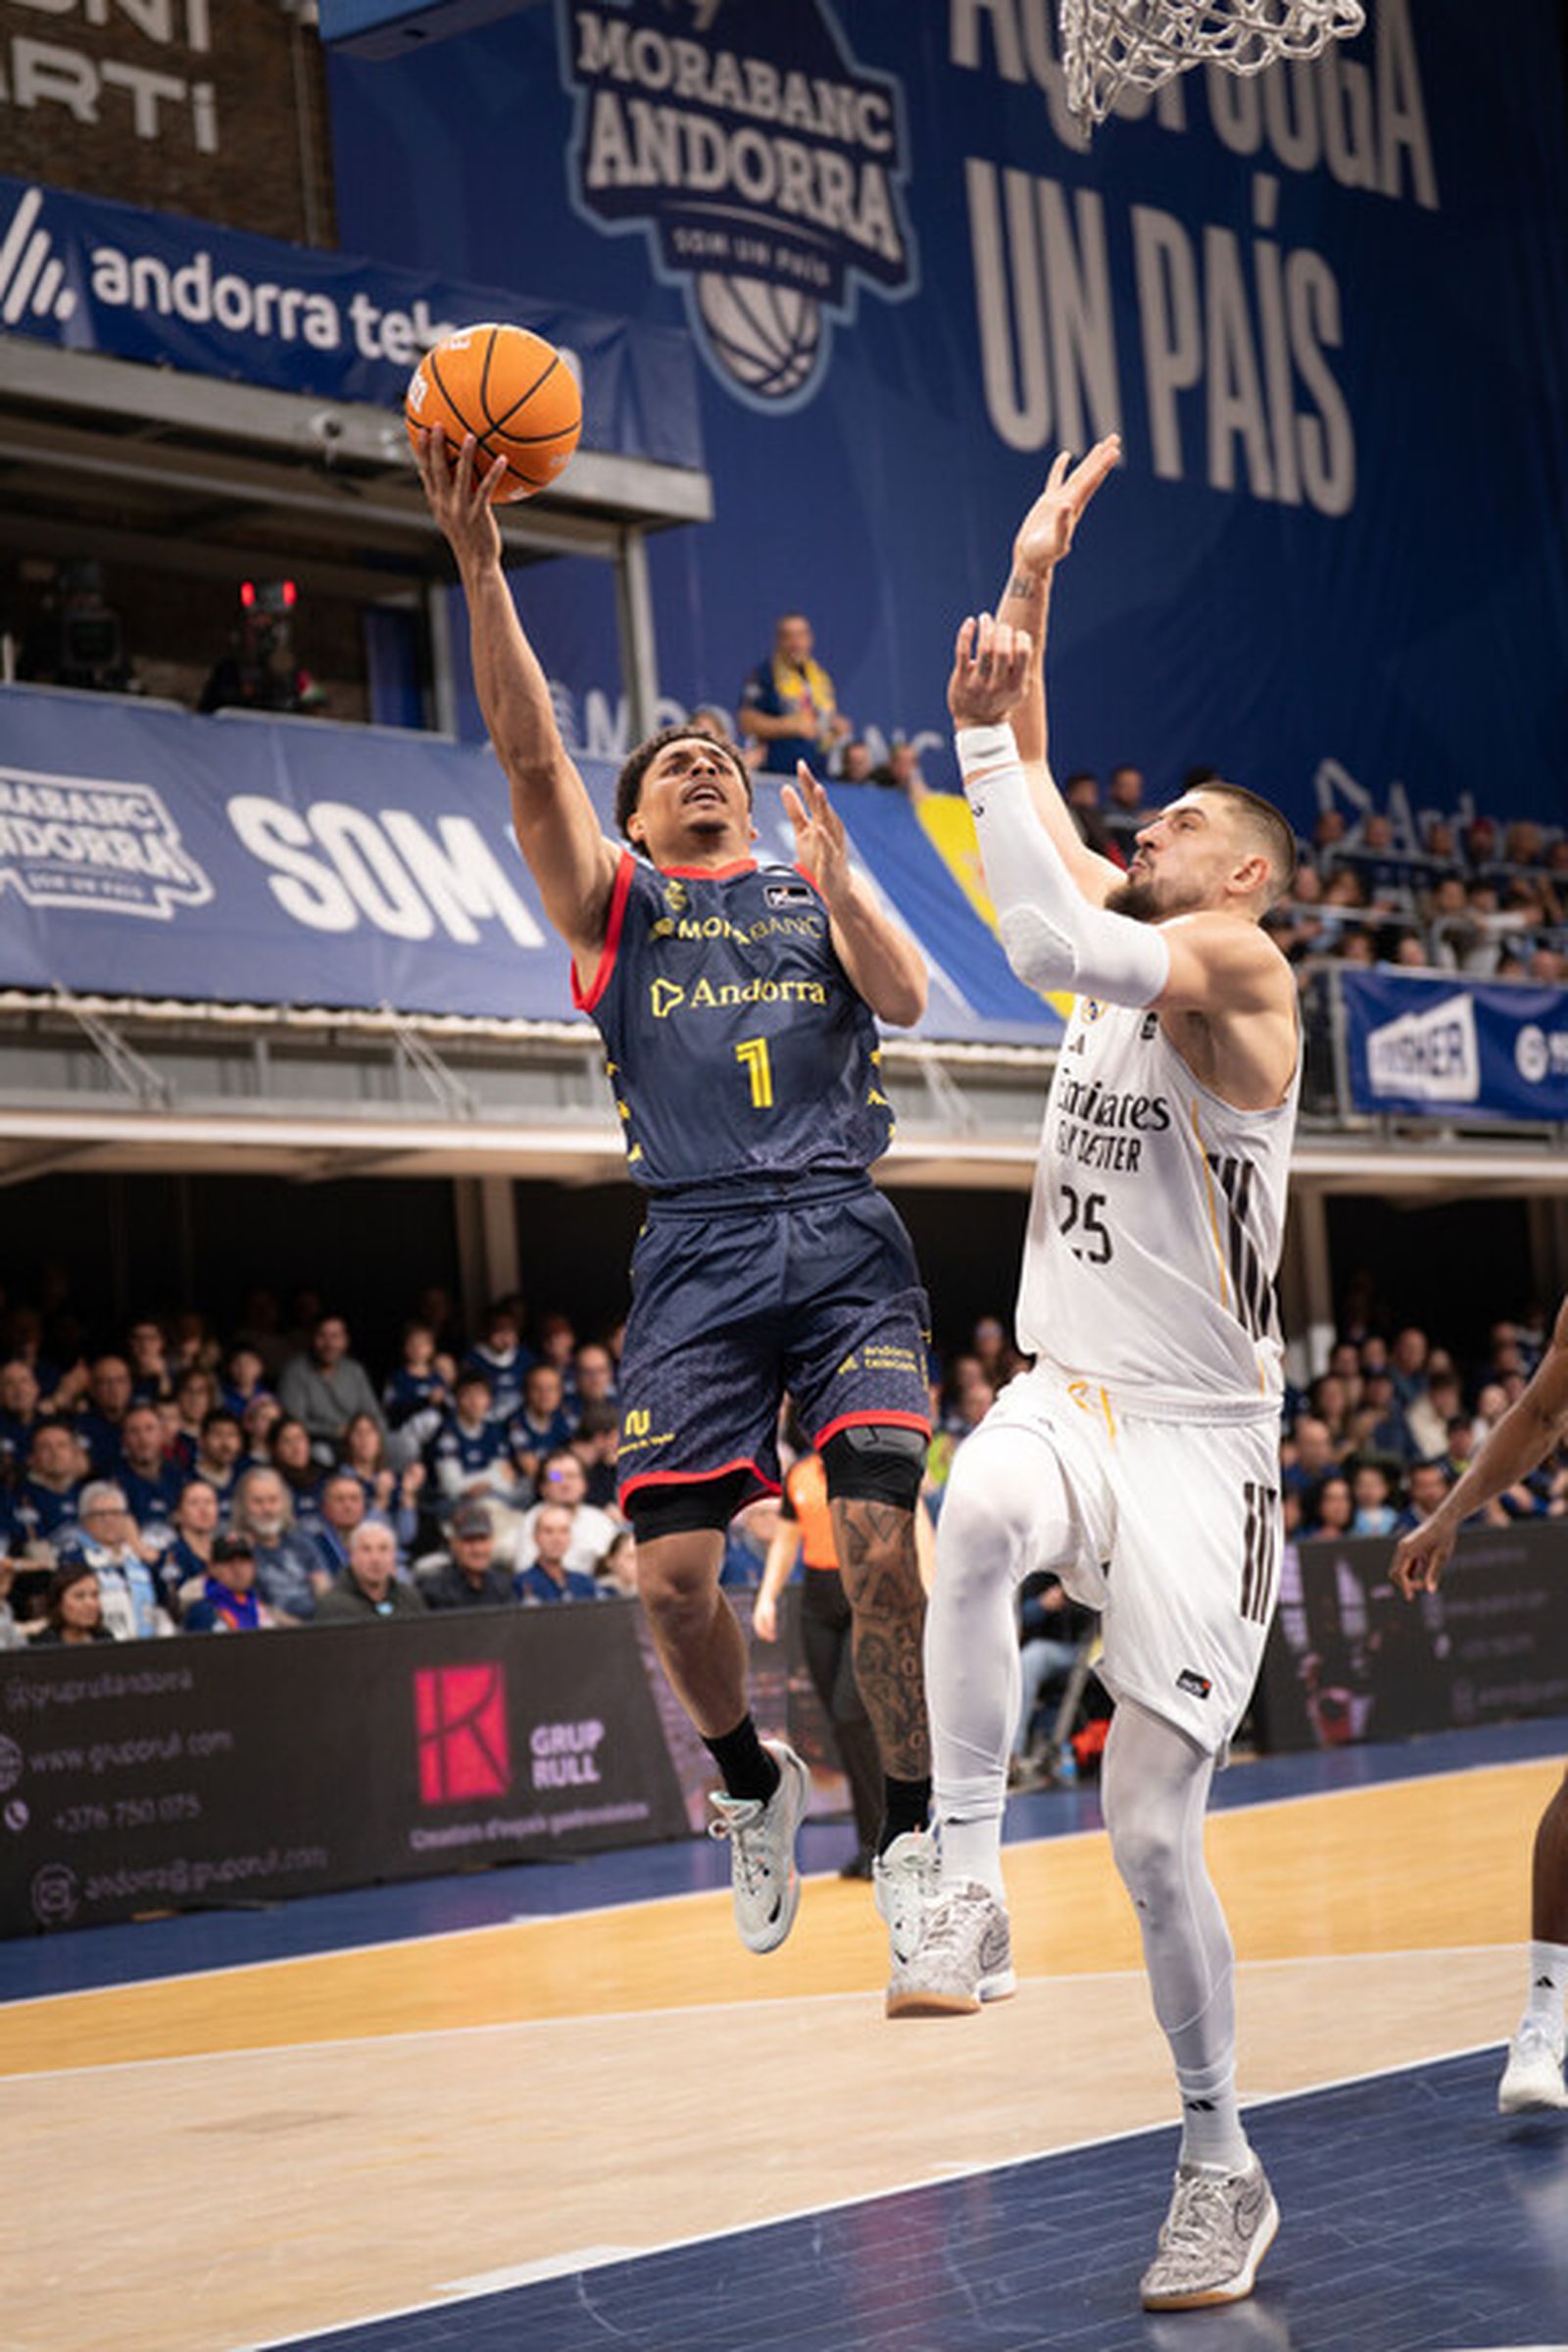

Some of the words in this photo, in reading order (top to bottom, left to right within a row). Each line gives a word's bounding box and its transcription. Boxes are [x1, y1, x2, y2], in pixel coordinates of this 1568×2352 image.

[576, 12, 892, 151] MORABANC
[586, 91, 904, 263] ANDORRA
[92, 248, 341, 351] andorra
[965, 157, 1125, 467] UN
[1130, 173, 1356, 517] PAÍS
[226, 795, 546, 948] SOM
[690, 977, 827, 1009] Andorra
[735, 1037, 773, 1108] 1
[1059, 1183, 1113, 1265] 25
[530, 1718, 605, 1757] GRUP
[532, 1753, 602, 1789] RULL
